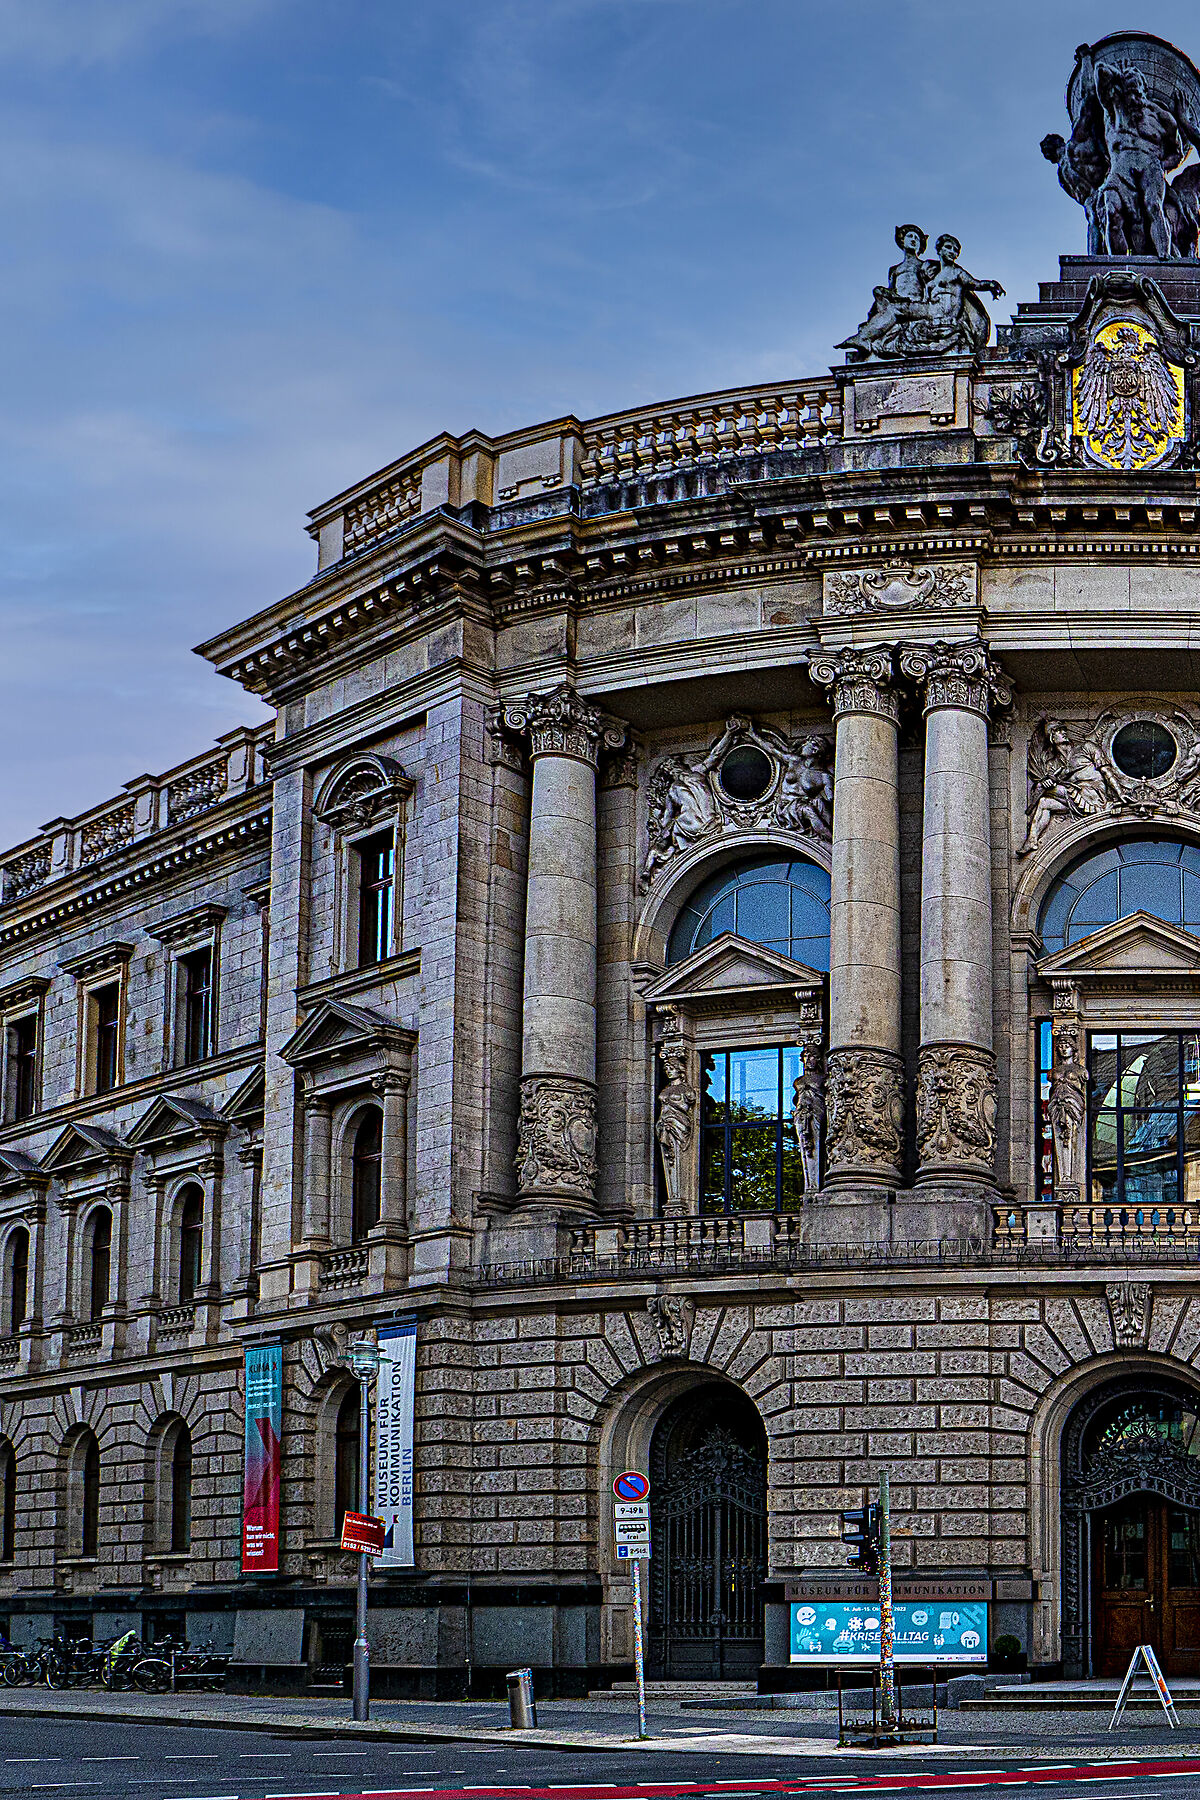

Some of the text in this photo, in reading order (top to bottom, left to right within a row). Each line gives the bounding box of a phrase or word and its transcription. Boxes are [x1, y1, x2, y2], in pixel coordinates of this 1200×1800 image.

[378, 1397, 389, 1508] MUSEUM FÜR
[389, 1361, 401, 1508] KOMMUNIKATION
[402, 1449, 412, 1506] BERLIN
[791, 1585, 985, 1594] MUSEUM FÜR MMUNIKATION
[839, 1629, 929, 1641] #KRISEALLTAG
